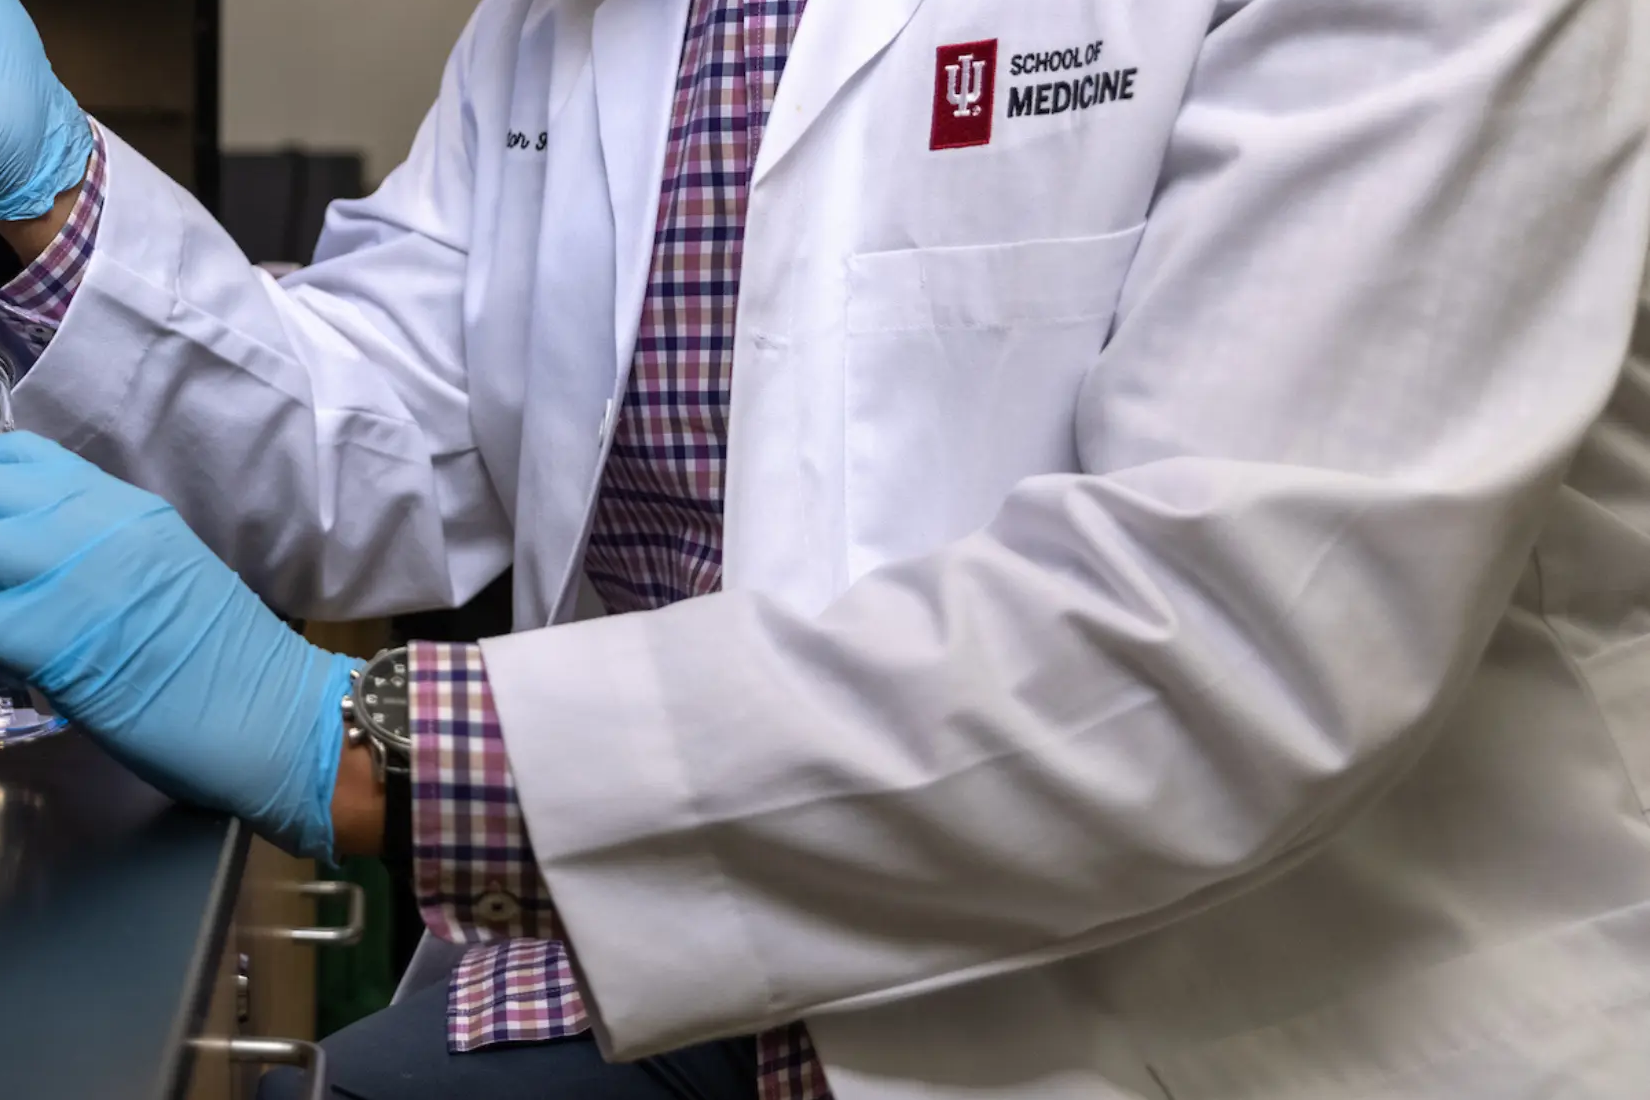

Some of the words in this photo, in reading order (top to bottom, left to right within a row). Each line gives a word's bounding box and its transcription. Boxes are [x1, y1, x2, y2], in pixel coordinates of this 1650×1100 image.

[1009, 47, 1083, 76] SCHOOL
[1085, 41, 1103, 66] OF
[1007, 68, 1139, 119] MEDICINE
